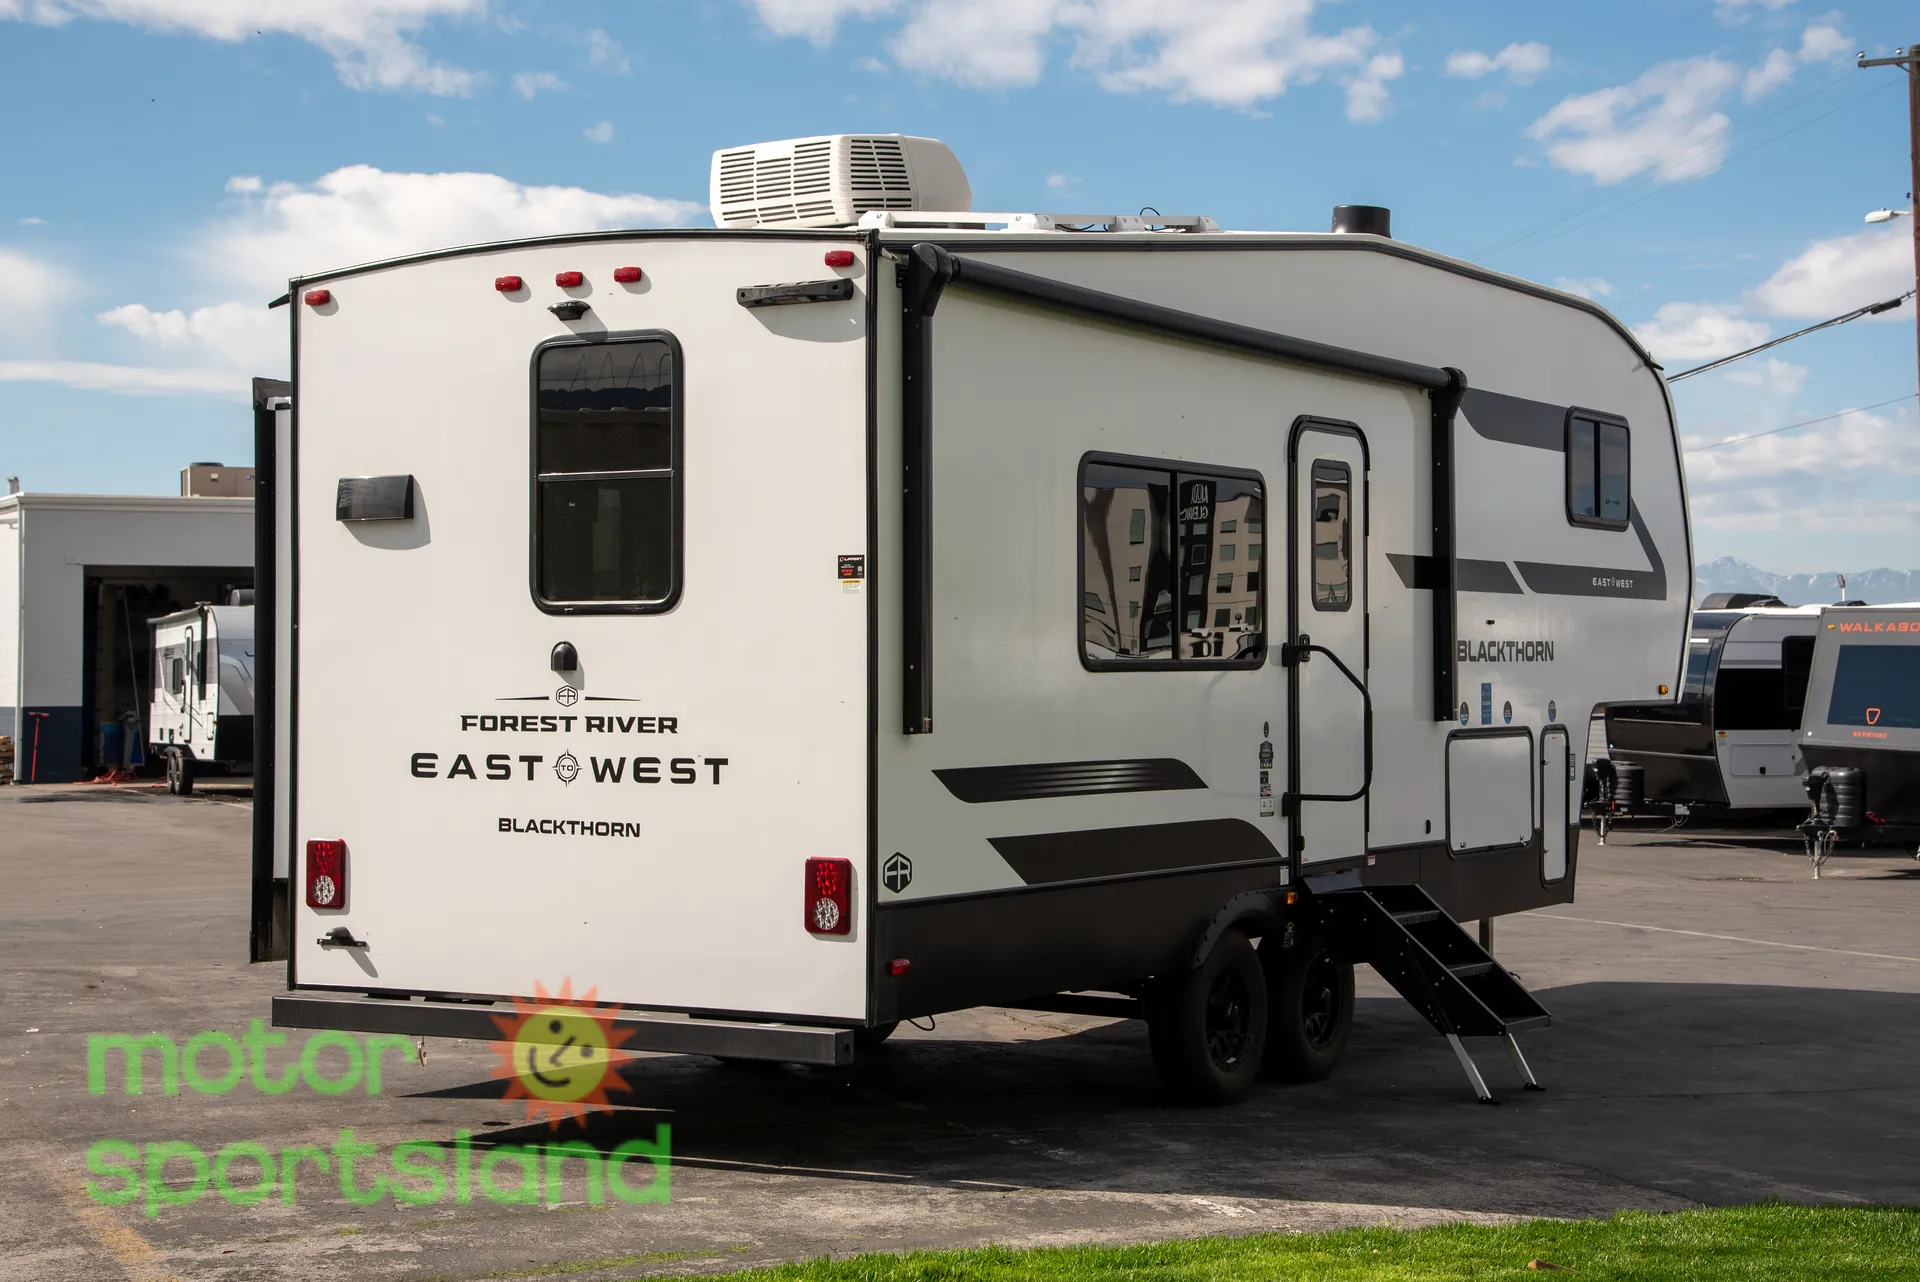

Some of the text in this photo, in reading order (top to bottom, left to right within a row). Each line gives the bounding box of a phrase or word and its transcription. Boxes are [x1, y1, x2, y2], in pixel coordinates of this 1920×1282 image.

[1592, 577, 1611, 588] EAST
[1615, 579, 1634, 589] WEST
[1839, 621, 1920, 633] WALKABO
[1457, 639, 1554, 663] BLACKTHORN
[460, 714, 678, 734] FOREST RIVER
[1852, 731, 1888, 739] KEYSTONE
[410, 752, 729, 785] EAST TO WEST
[498, 817, 641, 838] BLACKTHORN
